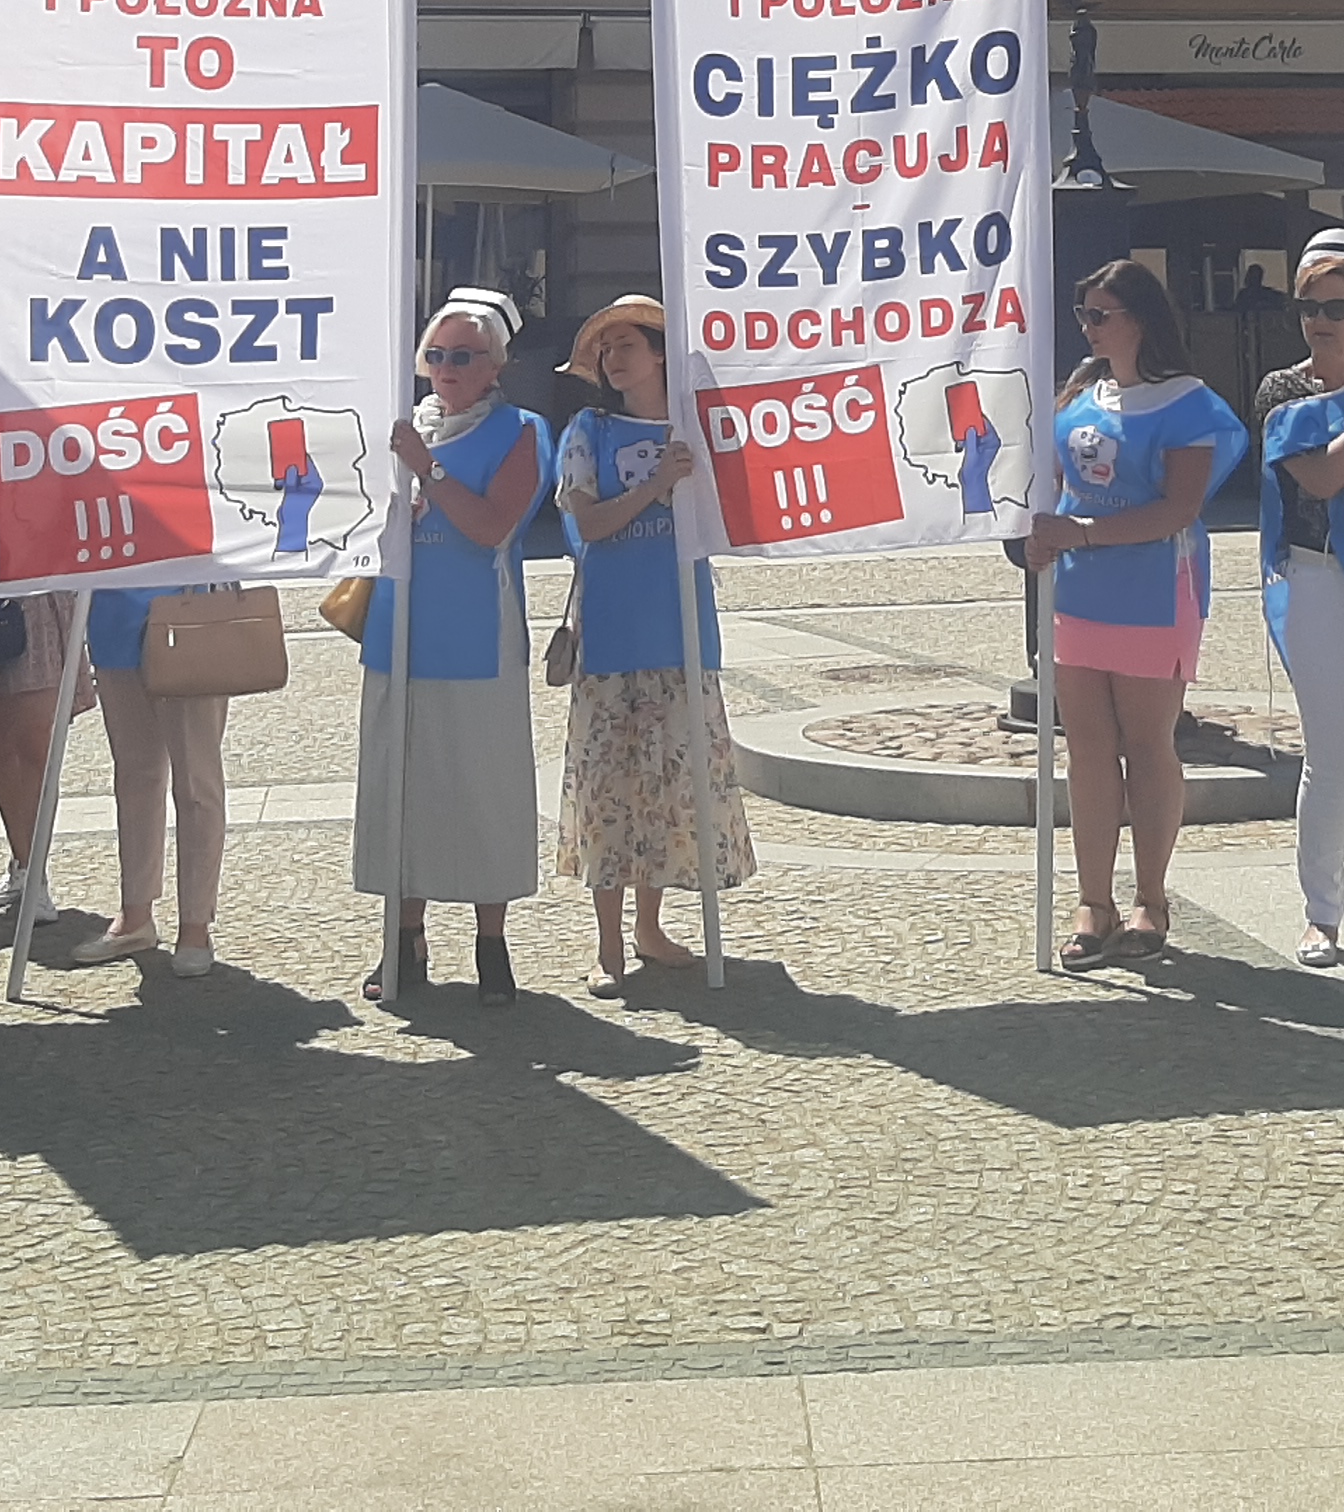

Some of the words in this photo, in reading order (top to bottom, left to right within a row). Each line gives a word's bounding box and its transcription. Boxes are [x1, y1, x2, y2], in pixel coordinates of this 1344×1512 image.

[136, 35, 236, 90] TO
[693, 29, 1021, 130] CIĘŻKO
[1188, 33, 1251, 66] Monte
[1251, 33, 1304, 64] Carlo
[707, 120, 1010, 189] PRACUJĄ
[77, 226, 129, 281] A
[160, 227, 290, 281] NIE
[704, 210, 1011, 289] SZYBKO
[29, 296, 334, 365] KOSZT
[702, 286, 1027, 350] ODCHODZĄ
[0, 400, 191, 484] DOŚĆ
[706, 374, 876, 452] DOŚĆ
[74, 494, 136, 563] !!!
[773, 463, 833, 530] !!!
